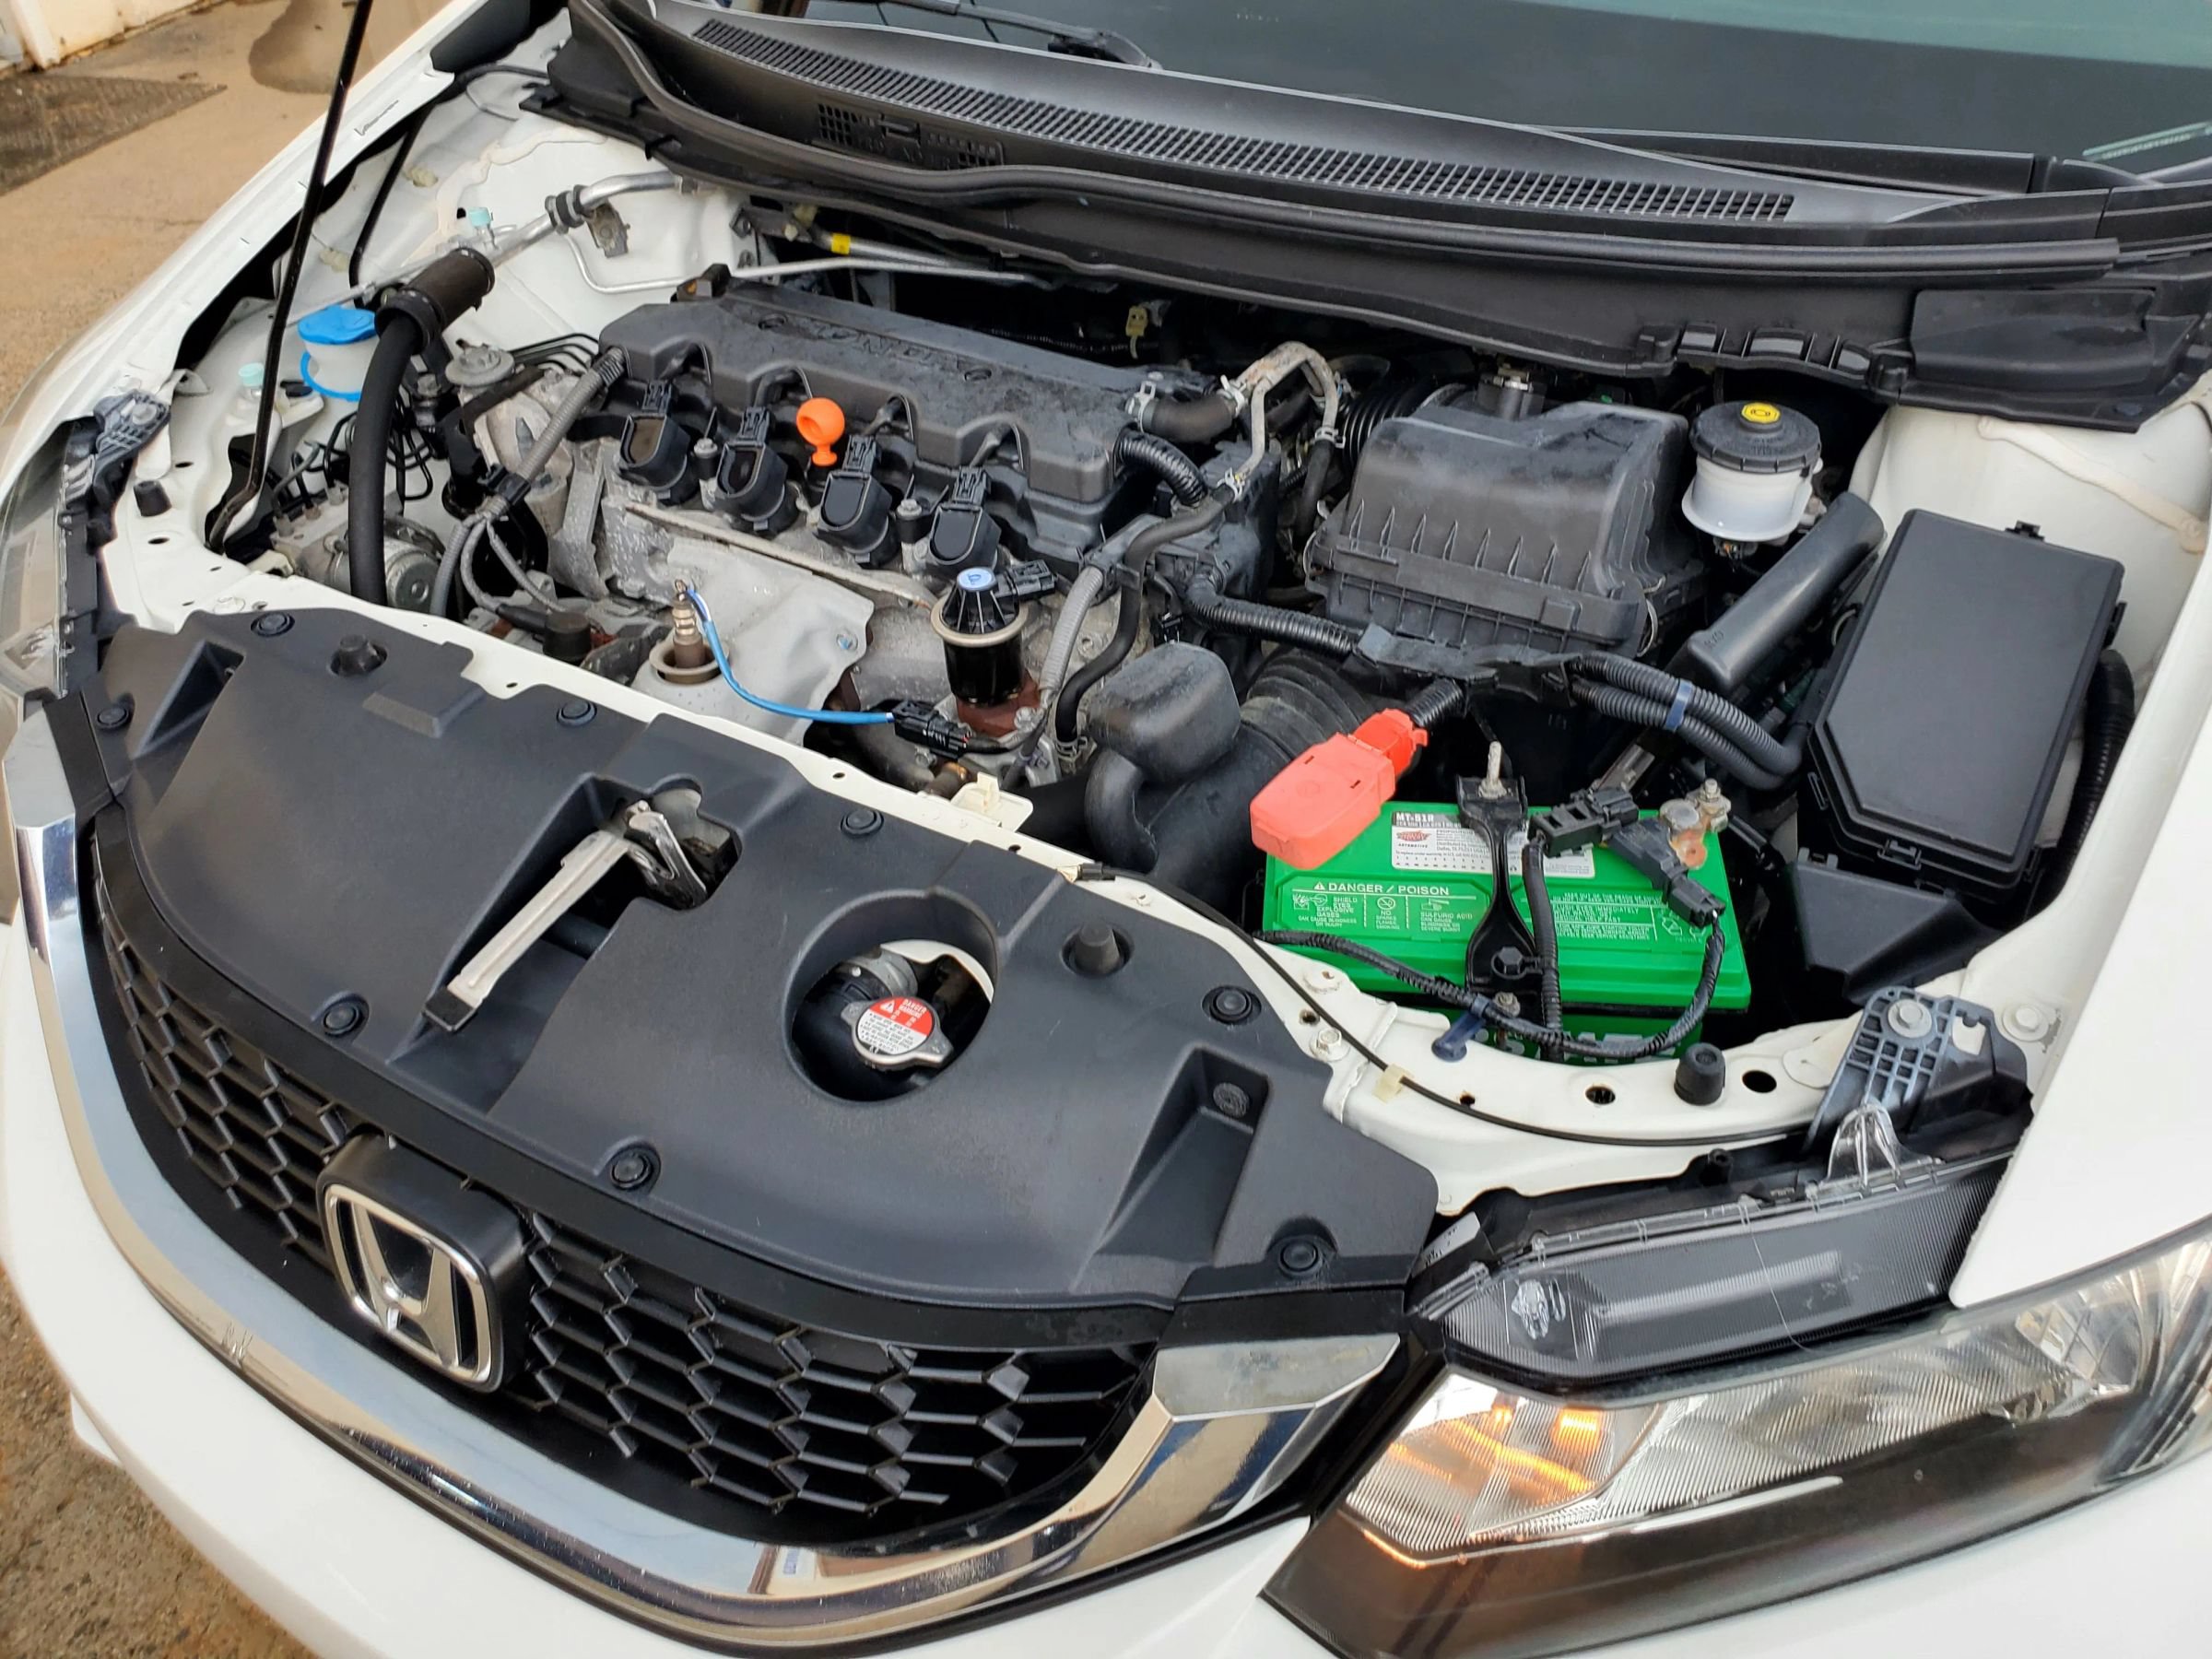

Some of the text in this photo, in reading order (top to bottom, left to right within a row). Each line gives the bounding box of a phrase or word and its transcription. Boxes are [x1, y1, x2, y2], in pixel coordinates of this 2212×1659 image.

[1328, 882, 1450, 895] DANGER / POISON
